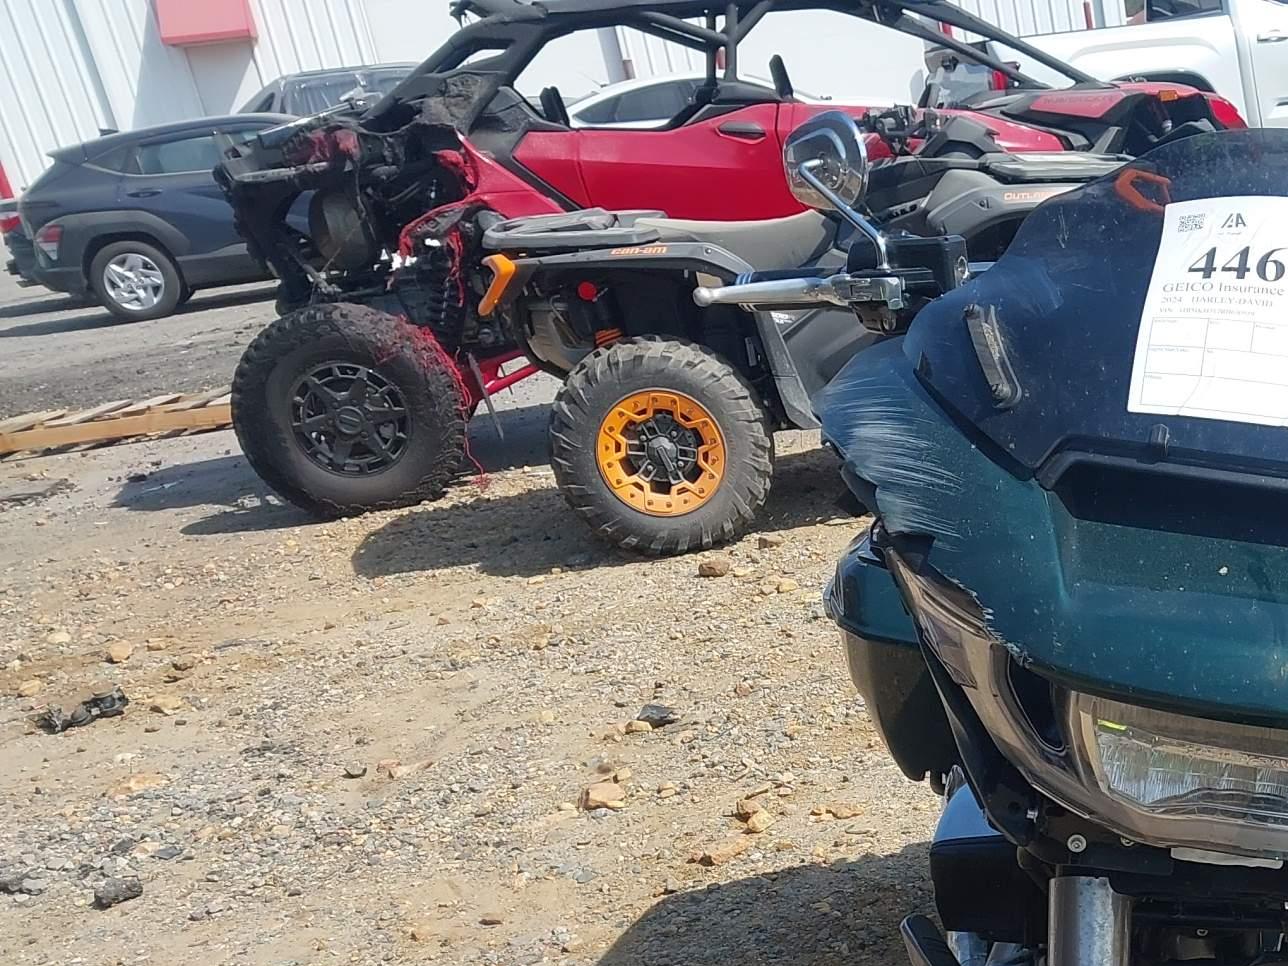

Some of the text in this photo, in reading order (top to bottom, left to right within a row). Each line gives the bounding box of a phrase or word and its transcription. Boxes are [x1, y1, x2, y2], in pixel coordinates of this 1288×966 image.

[611, 246, 667, 255] can-am
[1162, 281, 1214, 293] GEICO
[1219, 282, 1286, 296] Insurance
